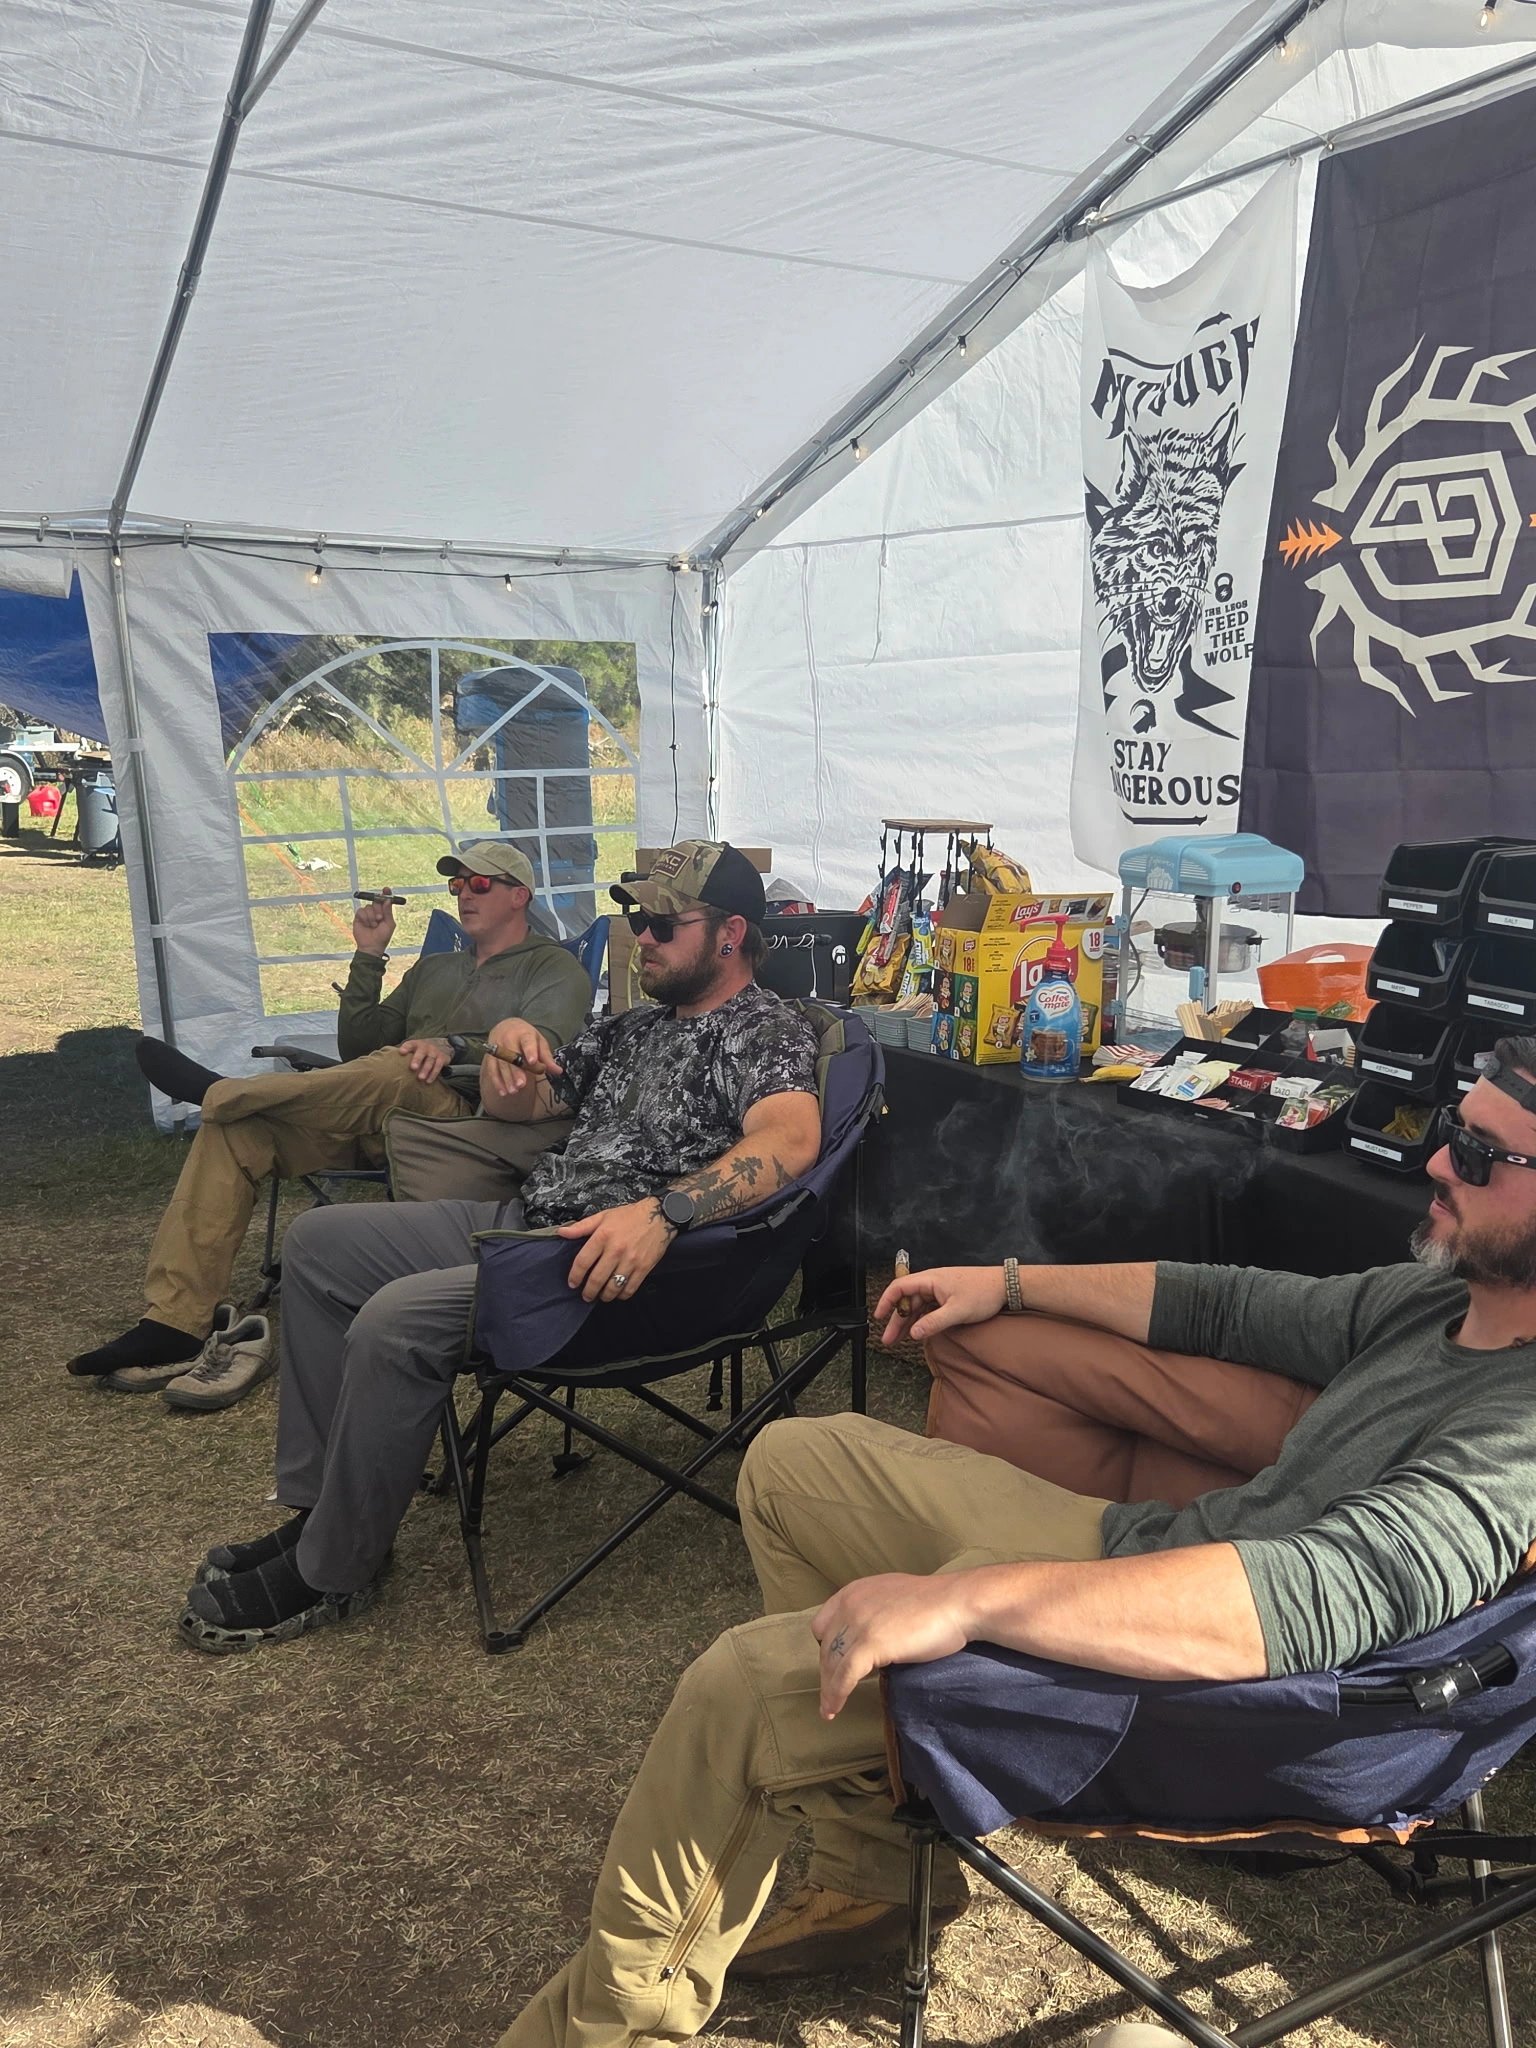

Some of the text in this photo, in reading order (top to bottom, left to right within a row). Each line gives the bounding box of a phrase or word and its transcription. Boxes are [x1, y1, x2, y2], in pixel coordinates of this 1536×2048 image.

[1205, 611, 1249, 634] FEED
[1210, 628, 1246, 649] THE
[1203, 643, 1254, 666] WOLF
[1114, 739, 1171, 772] STAY
[1110, 766, 1240, 806] GEROUS
[1089, 931, 1101, 948] 18
[1038, 992, 1070, 1004] Coffee
[1230, 1075, 1252, 1088] STASH
[1274, 1086, 1291, 1097] TAZO
